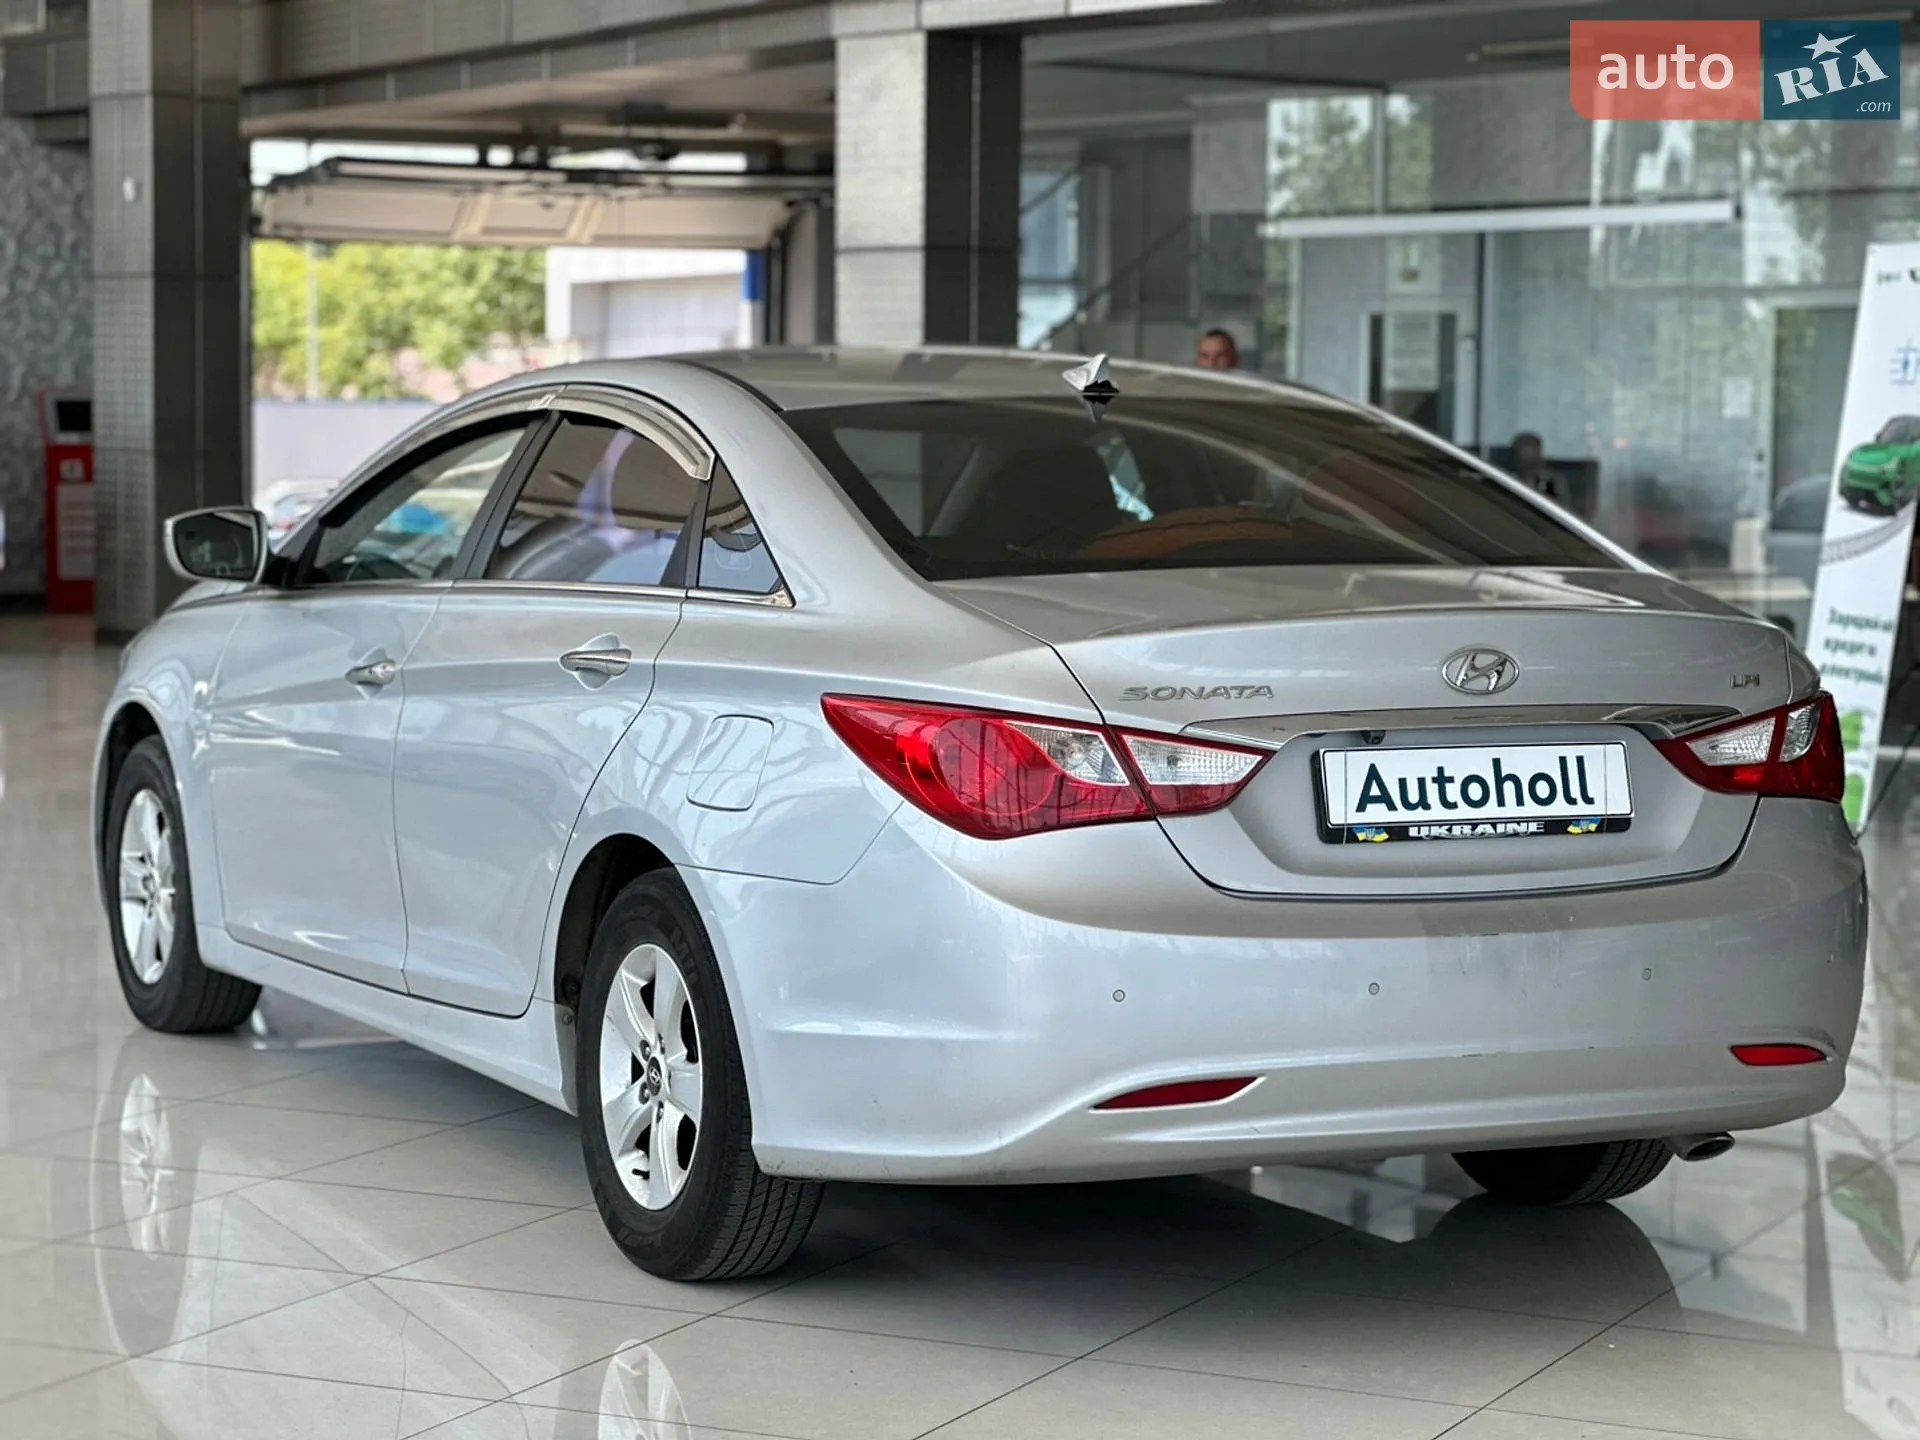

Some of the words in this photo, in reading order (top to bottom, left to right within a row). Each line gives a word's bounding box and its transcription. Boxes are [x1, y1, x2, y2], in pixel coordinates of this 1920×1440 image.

[1119, 685, 1275, 701] SONATA
[1355, 755, 1595, 813] Autoholl
[1408, 822, 1545, 838] UKRAINE
